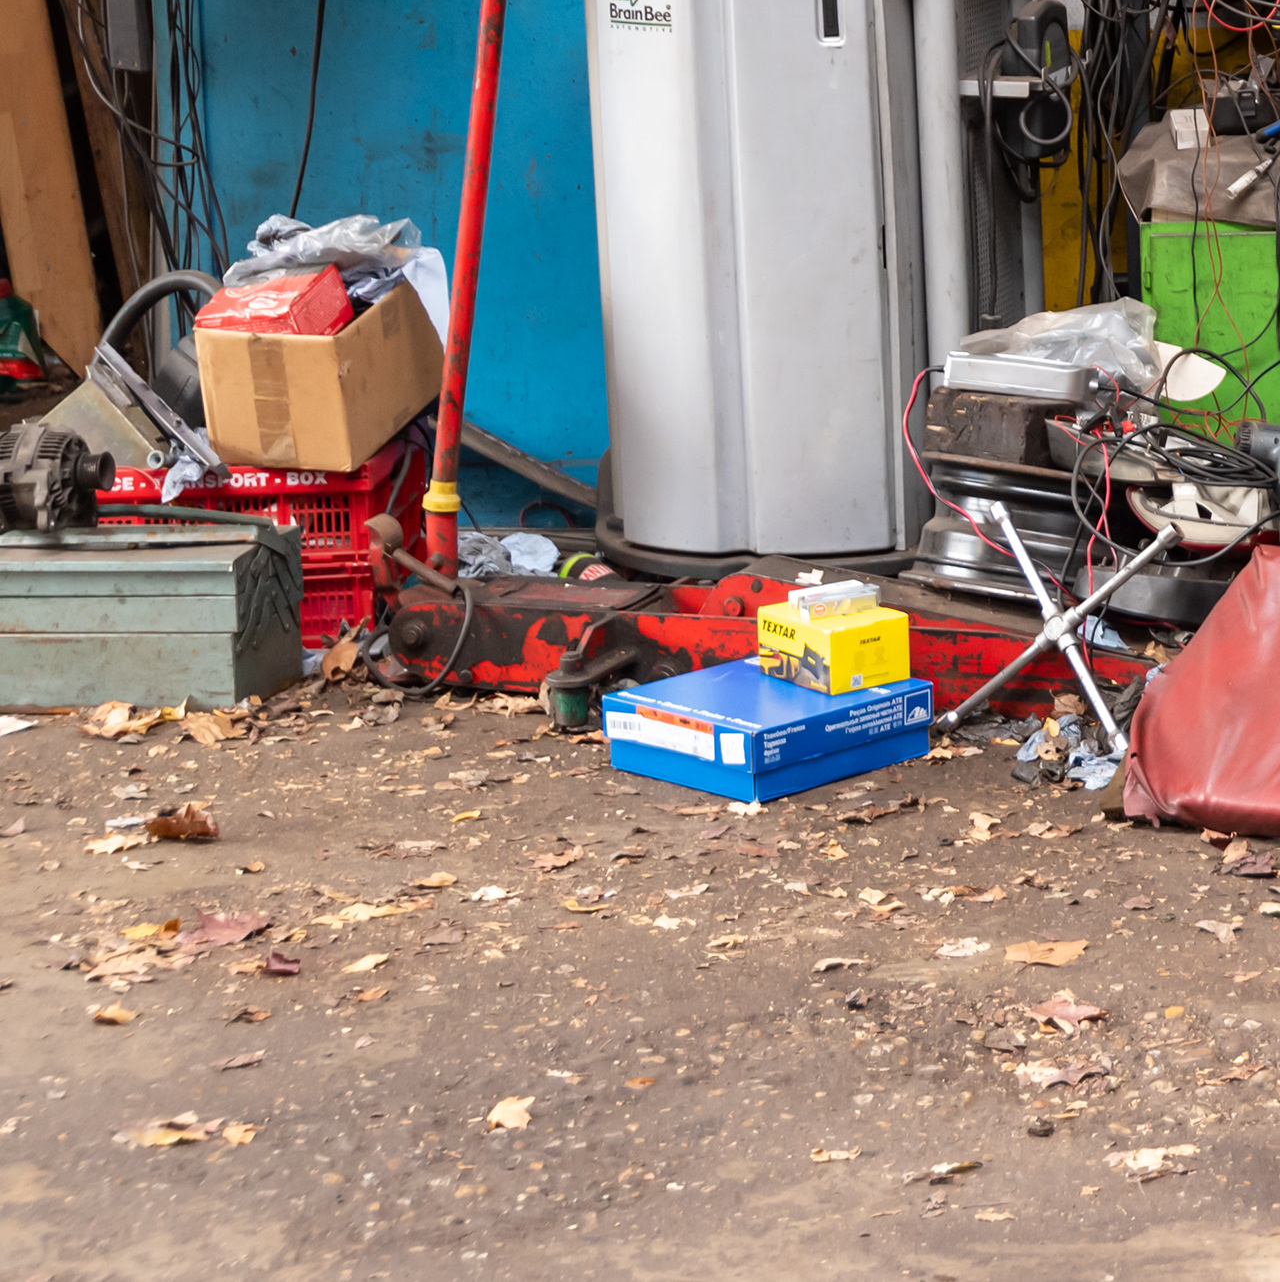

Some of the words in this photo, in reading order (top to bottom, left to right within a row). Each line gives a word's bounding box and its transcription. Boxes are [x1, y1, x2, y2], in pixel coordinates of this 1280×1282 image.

[610, 2, 643, 21] Brain
[610, 24, 673, 33] AUTOMOTIVE
[286, 471, 328, 486] BOX
[762, 620, 796, 640] TEXTAR
[860, 636, 881, 645] TEXTAR
